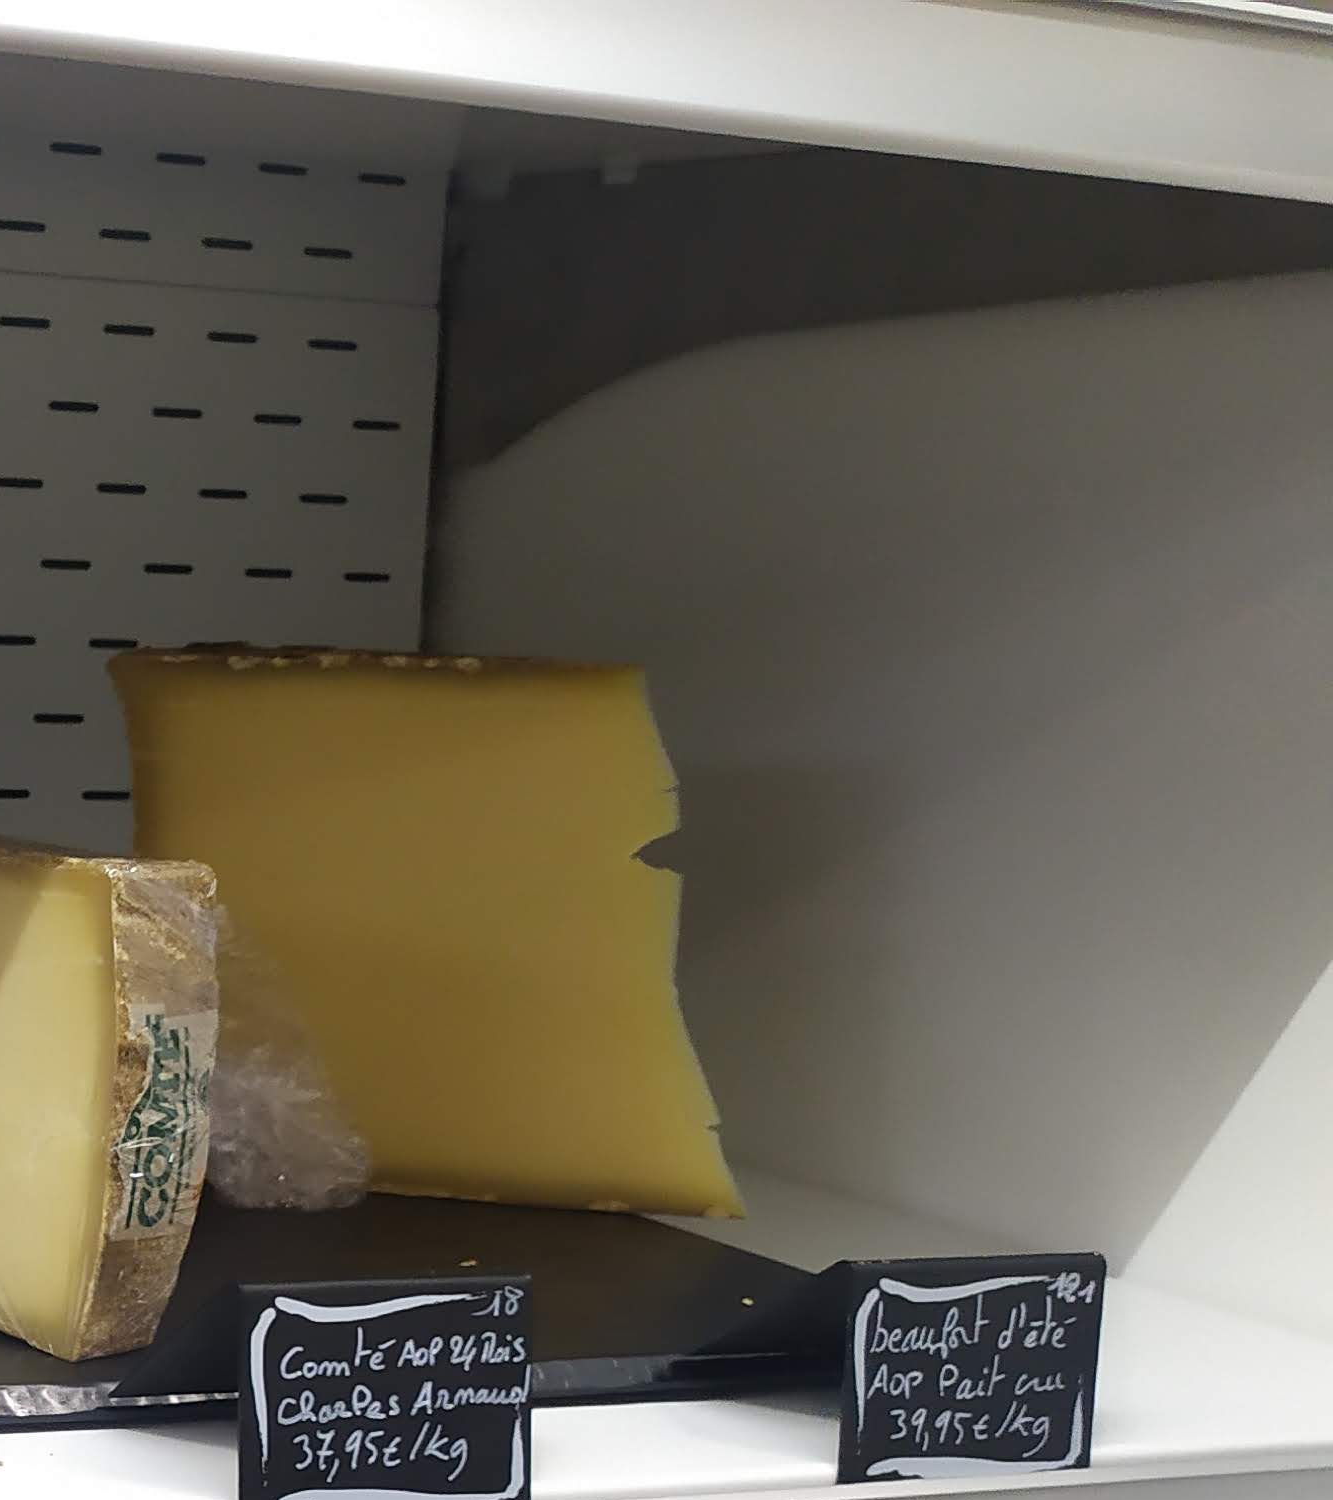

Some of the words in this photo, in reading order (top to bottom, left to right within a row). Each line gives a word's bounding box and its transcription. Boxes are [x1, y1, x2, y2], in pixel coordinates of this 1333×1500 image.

[470, 1285, 525, 1317] 18
[279, 1326, 396, 1380] Comté
[448, 1333, 476, 1372] 24
[410, 1363, 532, 1417] Arnaud
[1013, 1372, 1066, 1396] cru
